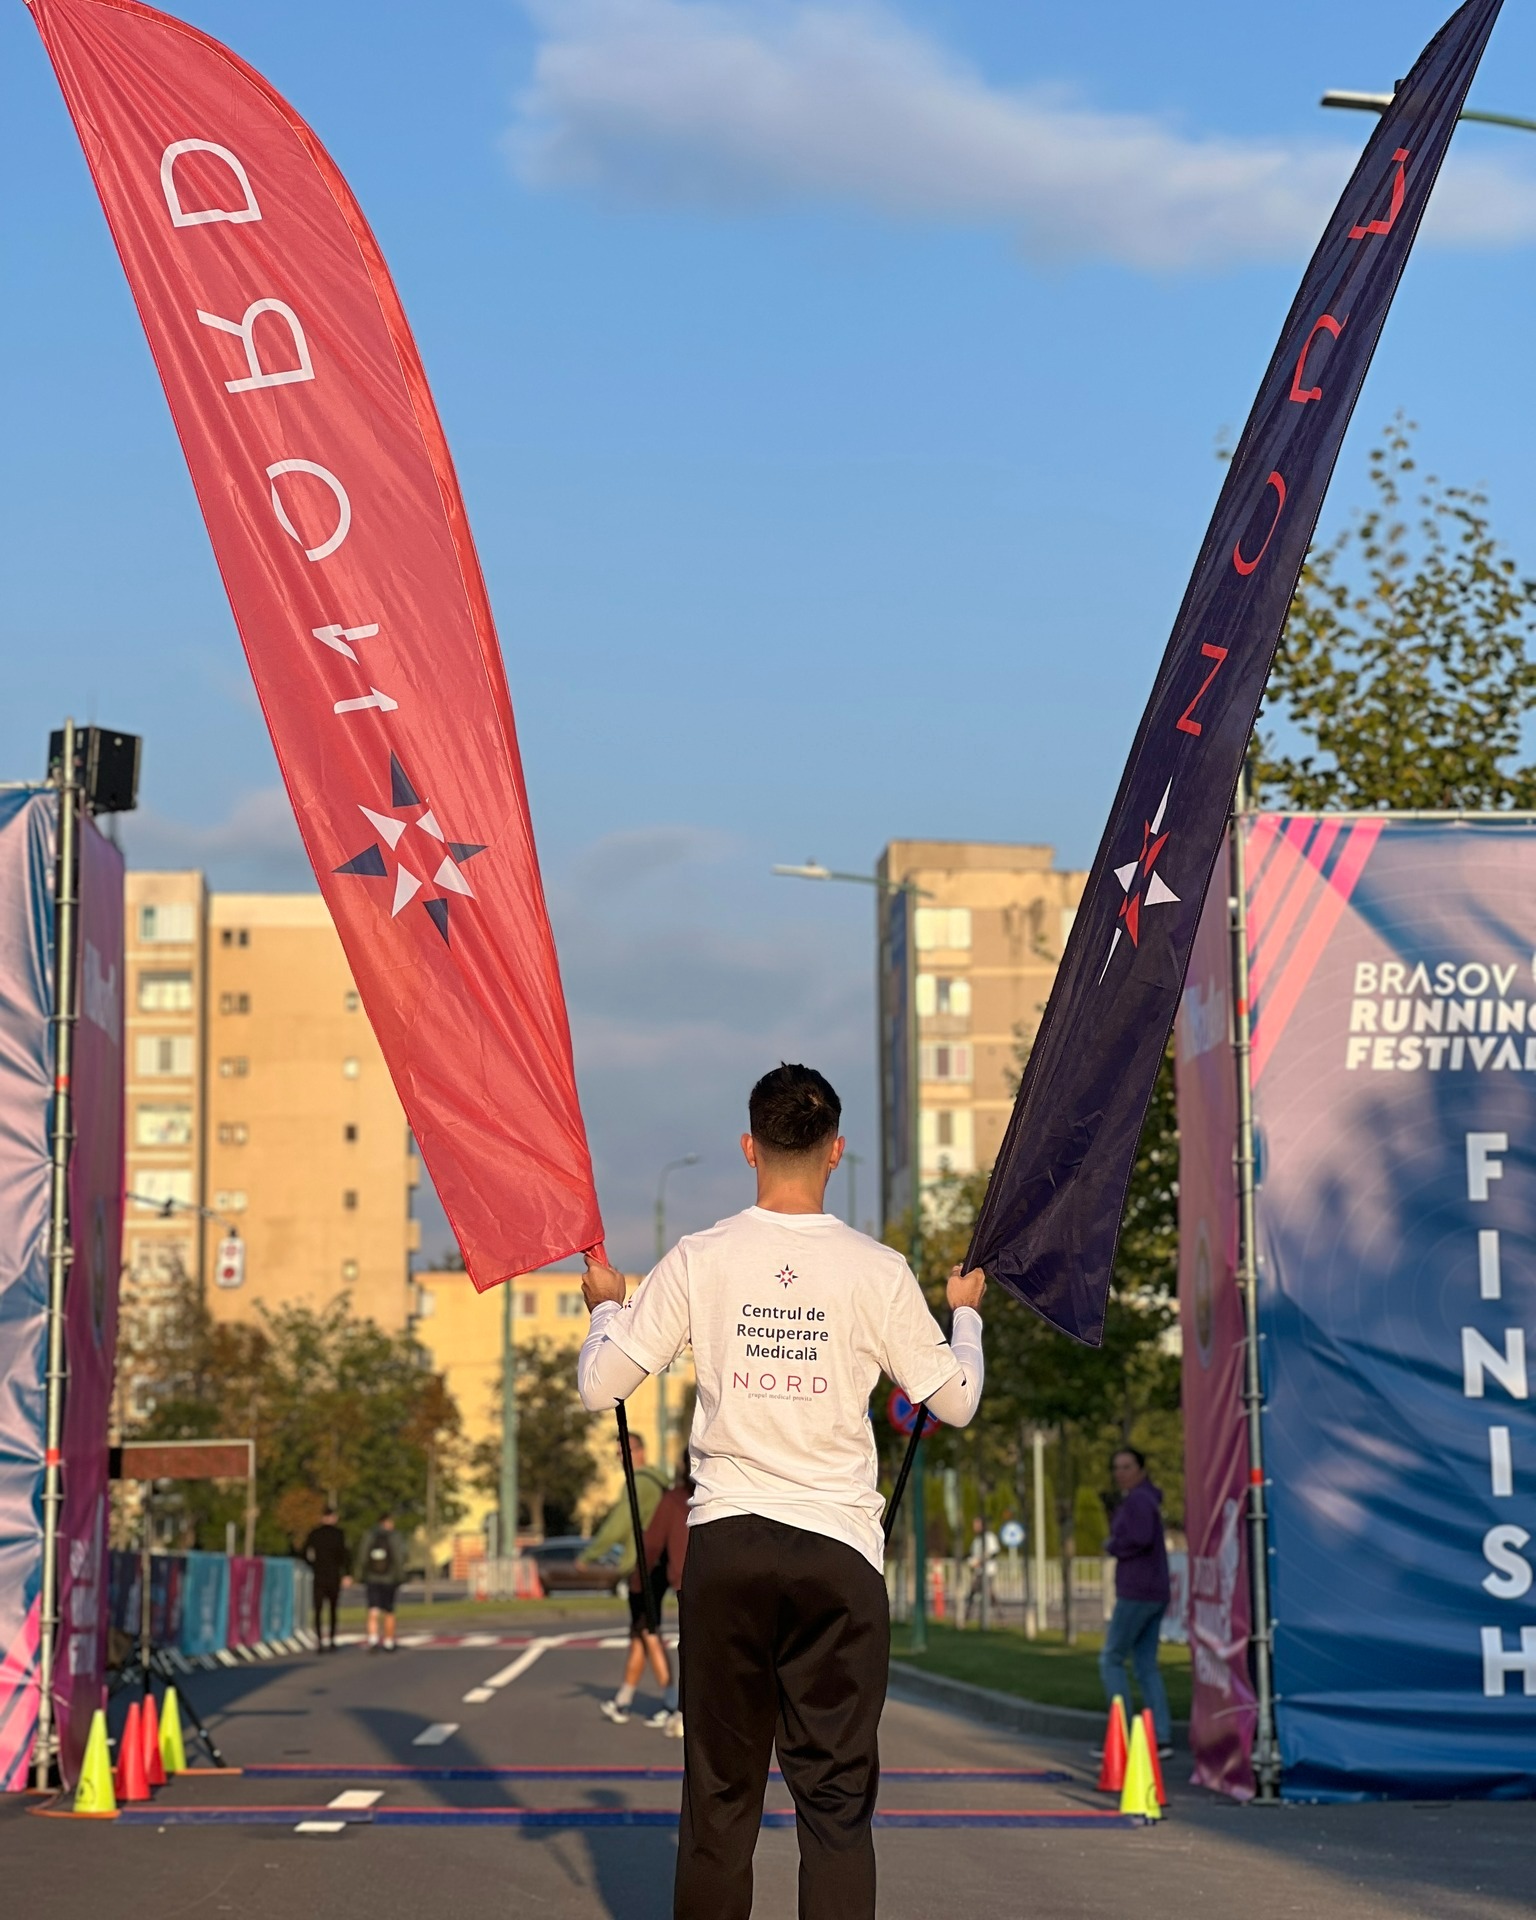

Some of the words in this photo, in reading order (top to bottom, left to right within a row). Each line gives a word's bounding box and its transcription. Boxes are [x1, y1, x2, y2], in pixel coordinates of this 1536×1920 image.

[1353, 961, 1518, 996] BRASOV
[741, 1303, 802, 1320] Centrul
[806, 1307, 825, 1321] de
[736, 1323, 829, 1342] Recuperare
[745, 1343, 818, 1361] Medicală
[733, 1371, 828, 1394] NORD
[768, 1393, 791, 1401] medical
[1461, 1132, 1536, 1697] FINISH
